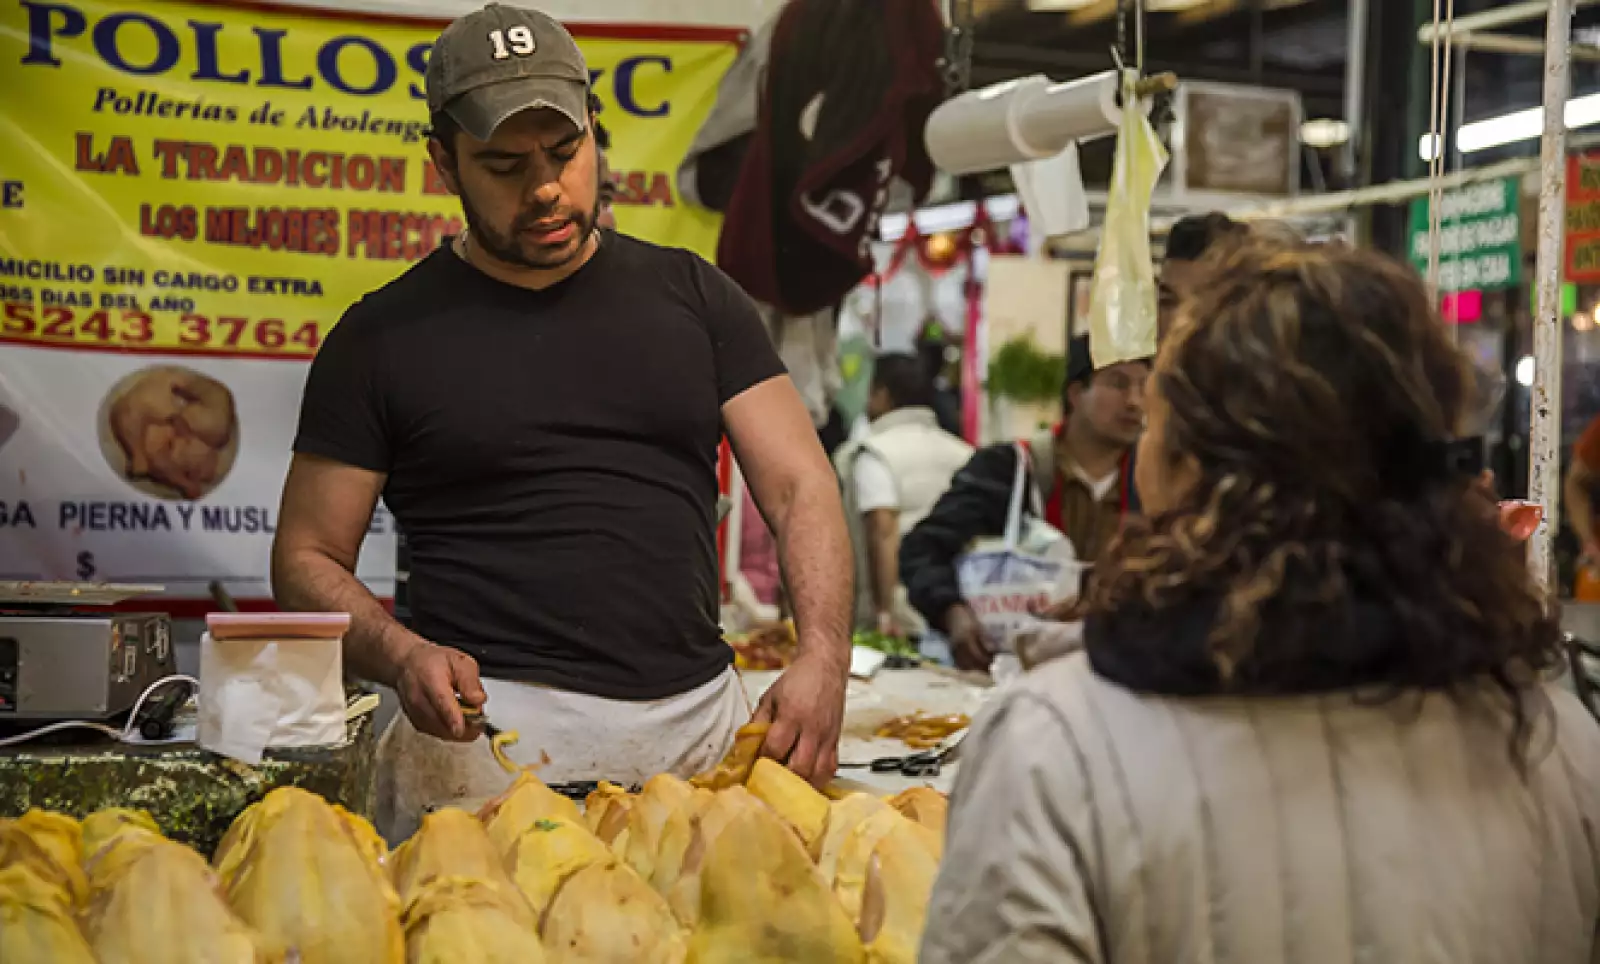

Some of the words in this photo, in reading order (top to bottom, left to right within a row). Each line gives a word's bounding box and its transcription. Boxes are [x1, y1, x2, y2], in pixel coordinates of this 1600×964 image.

[488, 25, 537, 60] 19
[248, 100, 284, 127] de
[296, 104, 432, 143] Aboleng
[75, 132, 140, 176] LA
[153, 138, 407, 195] TRADICION
[140, 202, 197, 241] LOS
[205, 206, 340, 257] MEJORES
[103, 267, 145, 287] SIN
[153, 270, 239, 292] CARGO
[247, 276, 324, 296] EXTRA
[41, 289, 93, 307] DIAS
[100, 294, 140, 311] DEL
[3, 303, 154, 342] 5243
[179, 314, 321, 349] 3764
[59, 502, 172, 531] PIERNA
[175, 505, 195, 530] Y
[201, 504, 274, 533] MUSL
[76, 551, 96, 580] $
